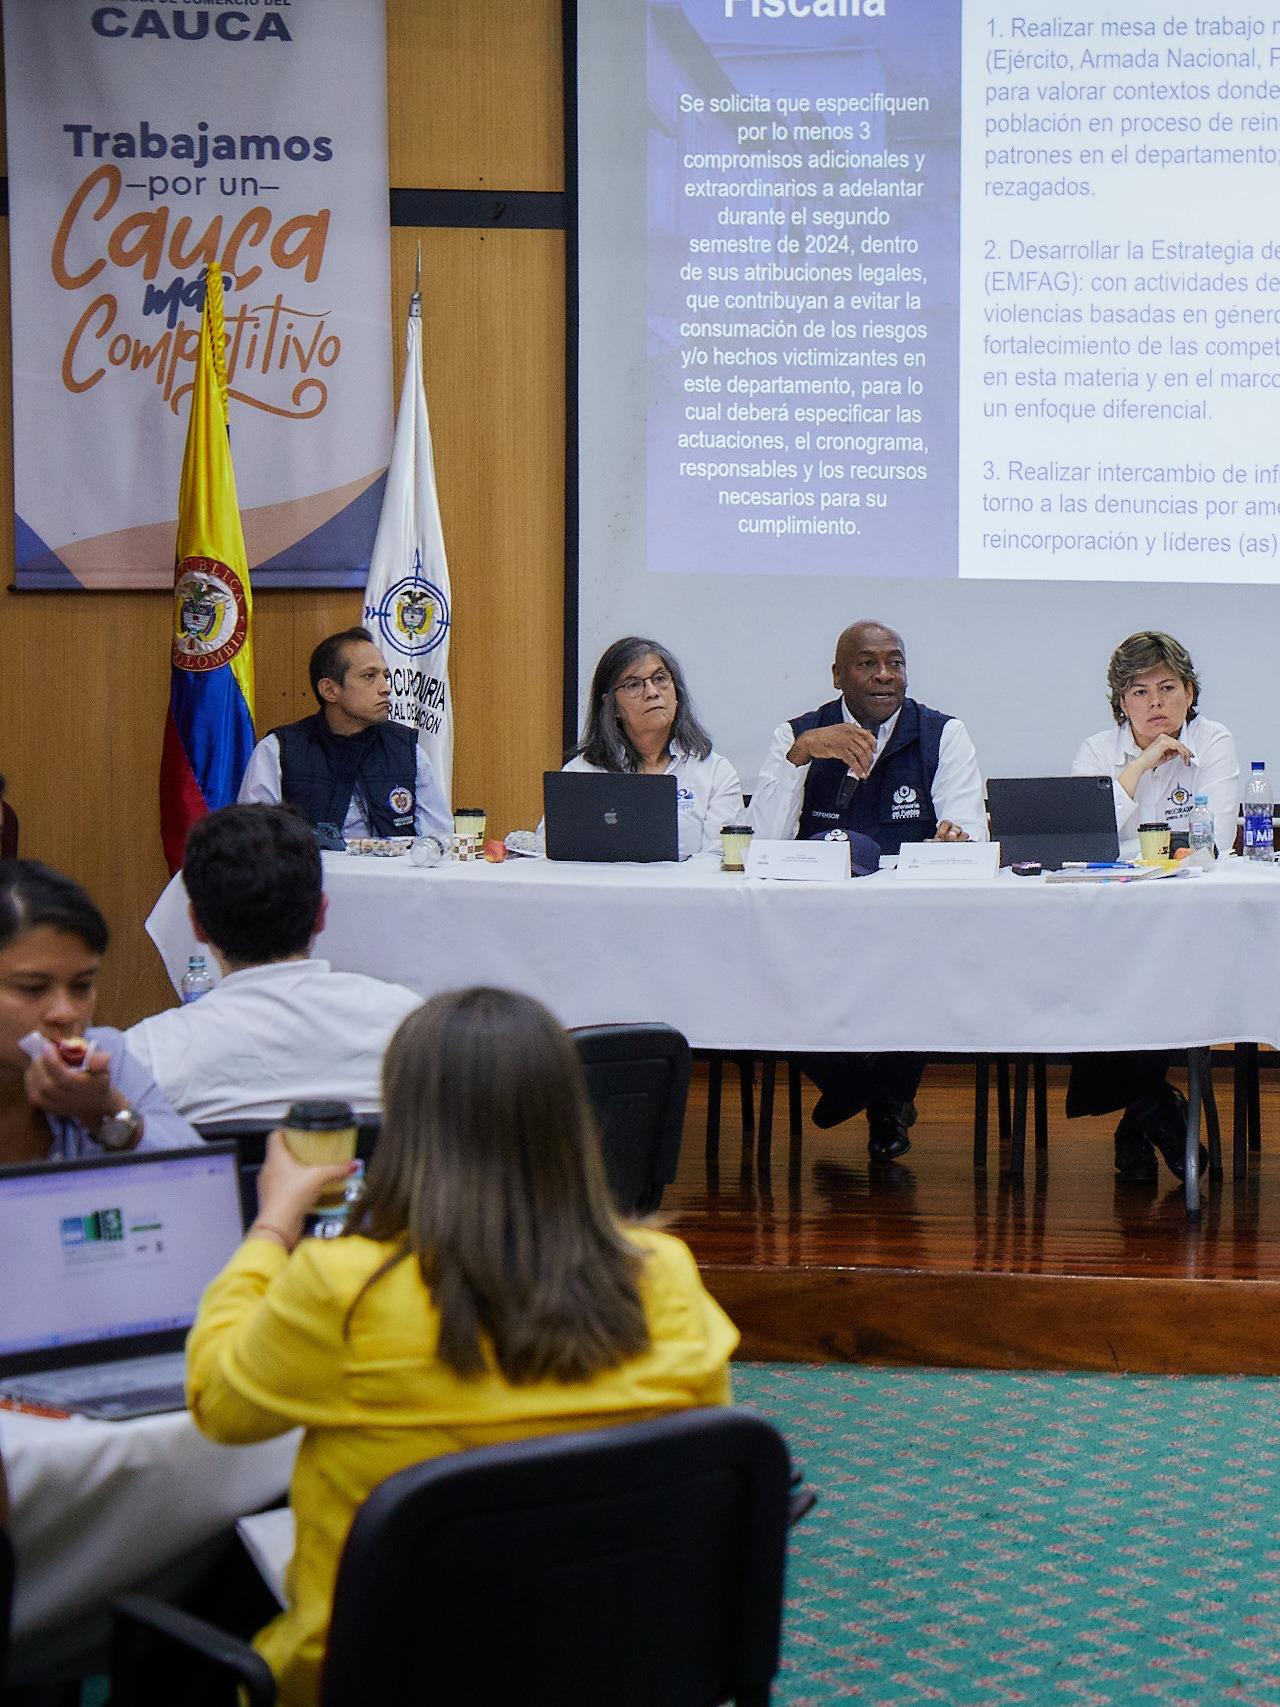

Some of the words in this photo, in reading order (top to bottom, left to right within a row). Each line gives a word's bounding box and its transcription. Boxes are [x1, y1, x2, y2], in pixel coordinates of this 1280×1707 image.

[91, 7, 292, 42] CAUCA
[988, 18, 1003, 37] 1.
[1012, 17, 1094, 37] Realizar
[1101, 21, 1155, 36] mesa
[1163, 16, 1188, 36] de
[1195, 16, 1265, 41] trabajo
[986, 49, 1074, 74] (Ejército,
[1080, 48, 1159, 68] Armada
[1167, 48, 1261, 70] Nacional,
[680, 94, 704, 112] Se
[710, 93, 771, 112] solicita
[777, 98, 810, 116] que
[816, 93, 929, 116] especifiquen
[738, 126, 768, 144] por
[772, 122, 788, 140] lo
[793, 126, 854, 140] menos
[860, 121, 870, 140] 3
[63, 122, 334, 168] Trabajamos
[683, 150, 803, 172] compromisos
[808, 150, 909, 168] adicionales
[915, 154, 925, 172] y
[685, 179, 817, 197] extraordinarios
[823, 183, 833, 197] a
[839, 179, 924, 197] adelantar
[51, 164, 331, 291] Cauca
[718, 207, 786, 225] durante
[791, 207, 806, 225] el
[812, 206, 890, 229] segundo
[690, 236, 771, 253] semestre
[777, 234, 799, 253] de
[805, 234, 854, 256] 2024,
[861, 235, 918, 253] dentro
[984, 239, 1001, 260] 2.
[1010, 239, 1120, 260] Desarrollar
[1127, 240, 1144, 260] la
[1152, 239, 1254, 265] Estrategia
[680, 262, 702, 280] de
[708, 267, 739, 281] sus
[744, 262, 852, 281] atribuciones
[859, 263, 927, 286] legales,
[984, 271, 1083, 296] (EMFAG):
[1091, 276, 1127, 291] con
[1134, 272, 1248, 292] actividades
[1256, 272, 1280, 292] de
[143, 267, 232, 329] má
[686, 294, 719, 313] que
[725, 291, 828, 314] contribuyan
[834, 296, 845, 309] a
[851, 291, 901, 309] evitar
[906, 291, 921, 309] la
[680, 319, 797, 338] consumación
[803, 319, 825, 338] de
[831, 320, 856, 338] los
[863, 320, 927, 343] riesgos
[61, 294, 341, 402] Comptitivo
[681, 347, 708, 369] y/o
[714, 347, 778, 365] hechos
[783, 348, 898, 366] victimizantes
[904, 353, 925, 366] en
[684, 375, 722, 392] este
[727, 375, 855, 397] departamento,
[862, 381, 901, 398] para
[908, 377, 923, 395] lo
[685, 402, 721, 420] cual
[727, 403, 789, 421] deberá
[794, 404, 891, 426] especificar
[896, 404, 922, 423] las
[678, 430, 789, 452] actuaciones,
[795, 432, 810, 450] el
[816, 436, 928, 455] cronograma,
[680, 460, 797, 481] responsables
[803, 464, 813, 483] y
[819, 460, 844, 479] los
[851, 465, 927, 479] recursos
[983, 460, 1000, 480] 3.
[1009, 460, 1091, 482] Realizar
[1098, 462, 1215, 483] intercambio
[1222, 464, 1247, 483] de
[719, 488, 815, 506] necesarios
[821, 492, 860, 511] para
[866, 493, 887, 507] su
[738, 516, 860, 538] cumplimiento.
